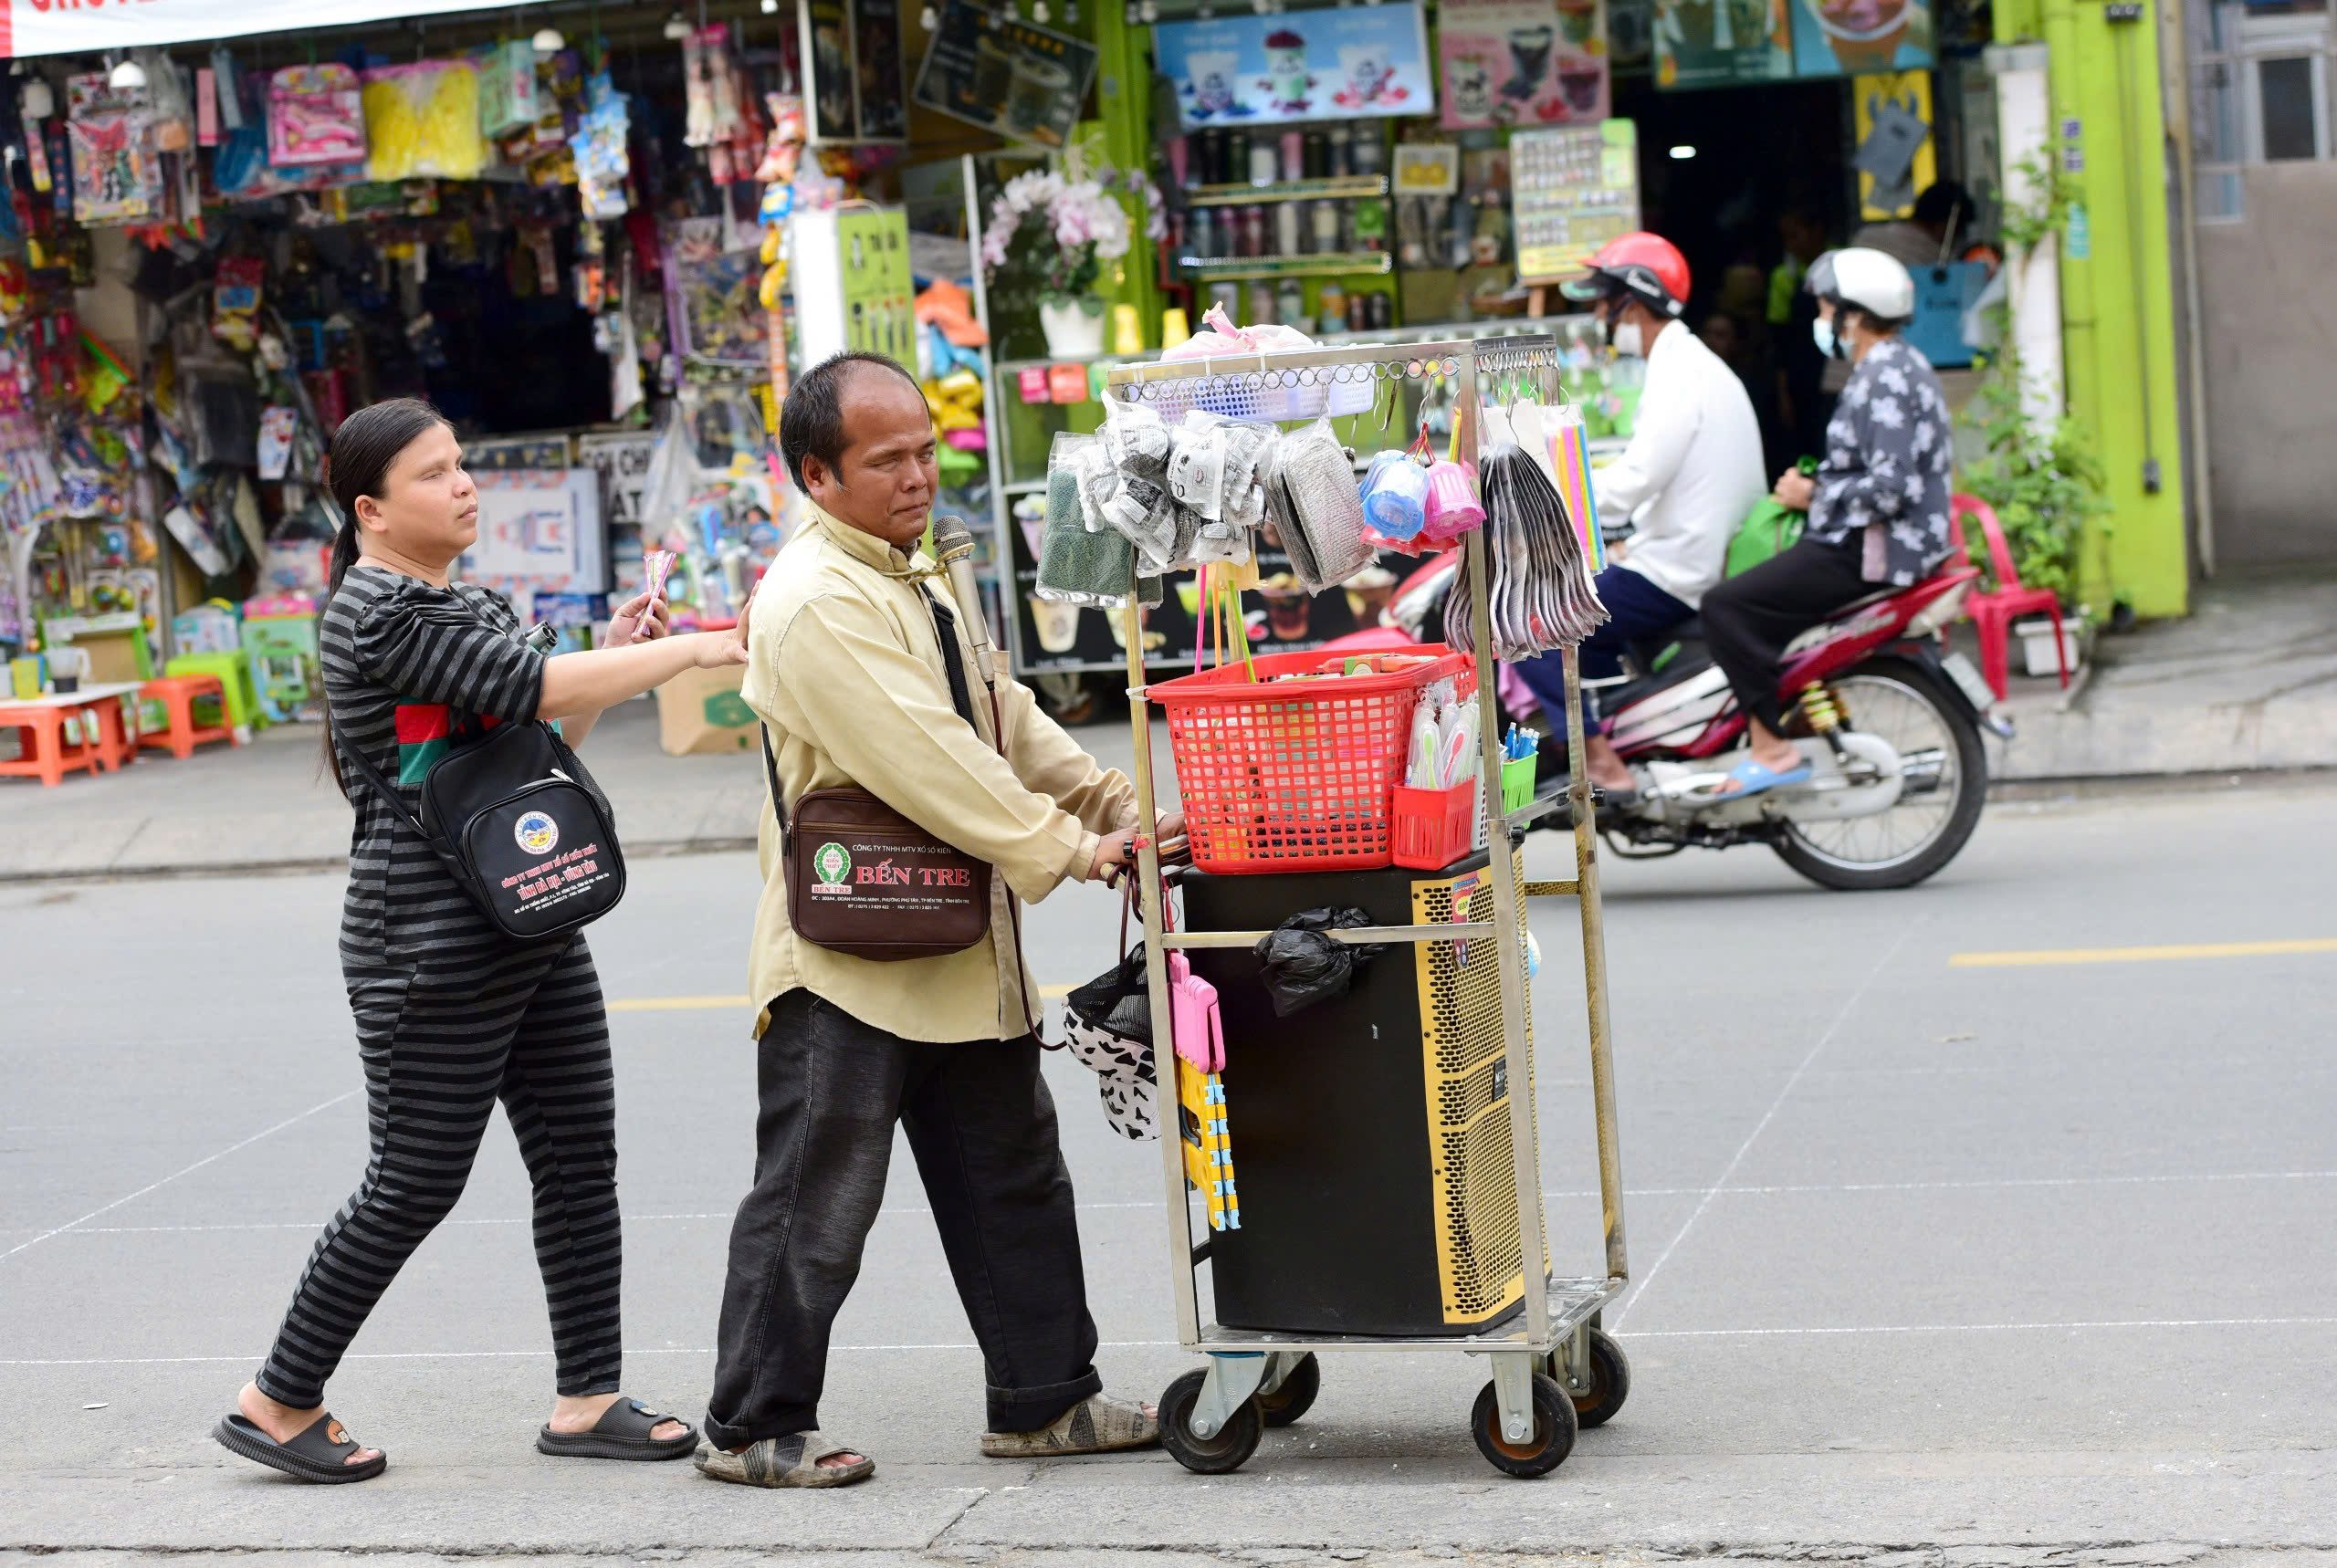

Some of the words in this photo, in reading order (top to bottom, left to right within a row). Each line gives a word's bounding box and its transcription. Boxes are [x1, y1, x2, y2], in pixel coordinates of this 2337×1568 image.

[501, 877, 519, 888] CÔNG
[516, 873, 526, 882] TY
[525, 866, 542, 878] TNHH
[517, 883, 538, 901] TỈNH
[534, 877, 549, 894] BÀ
[546, 873, 562, 889] RỊA
[562, 866, 585, 883] VŨNG
[581, 860, 598, 874] TÀU
[855, 858, 911, 885] BẾN
[917, 868, 970, 886] TRE
[813, 884, 831, 893] BẾN
